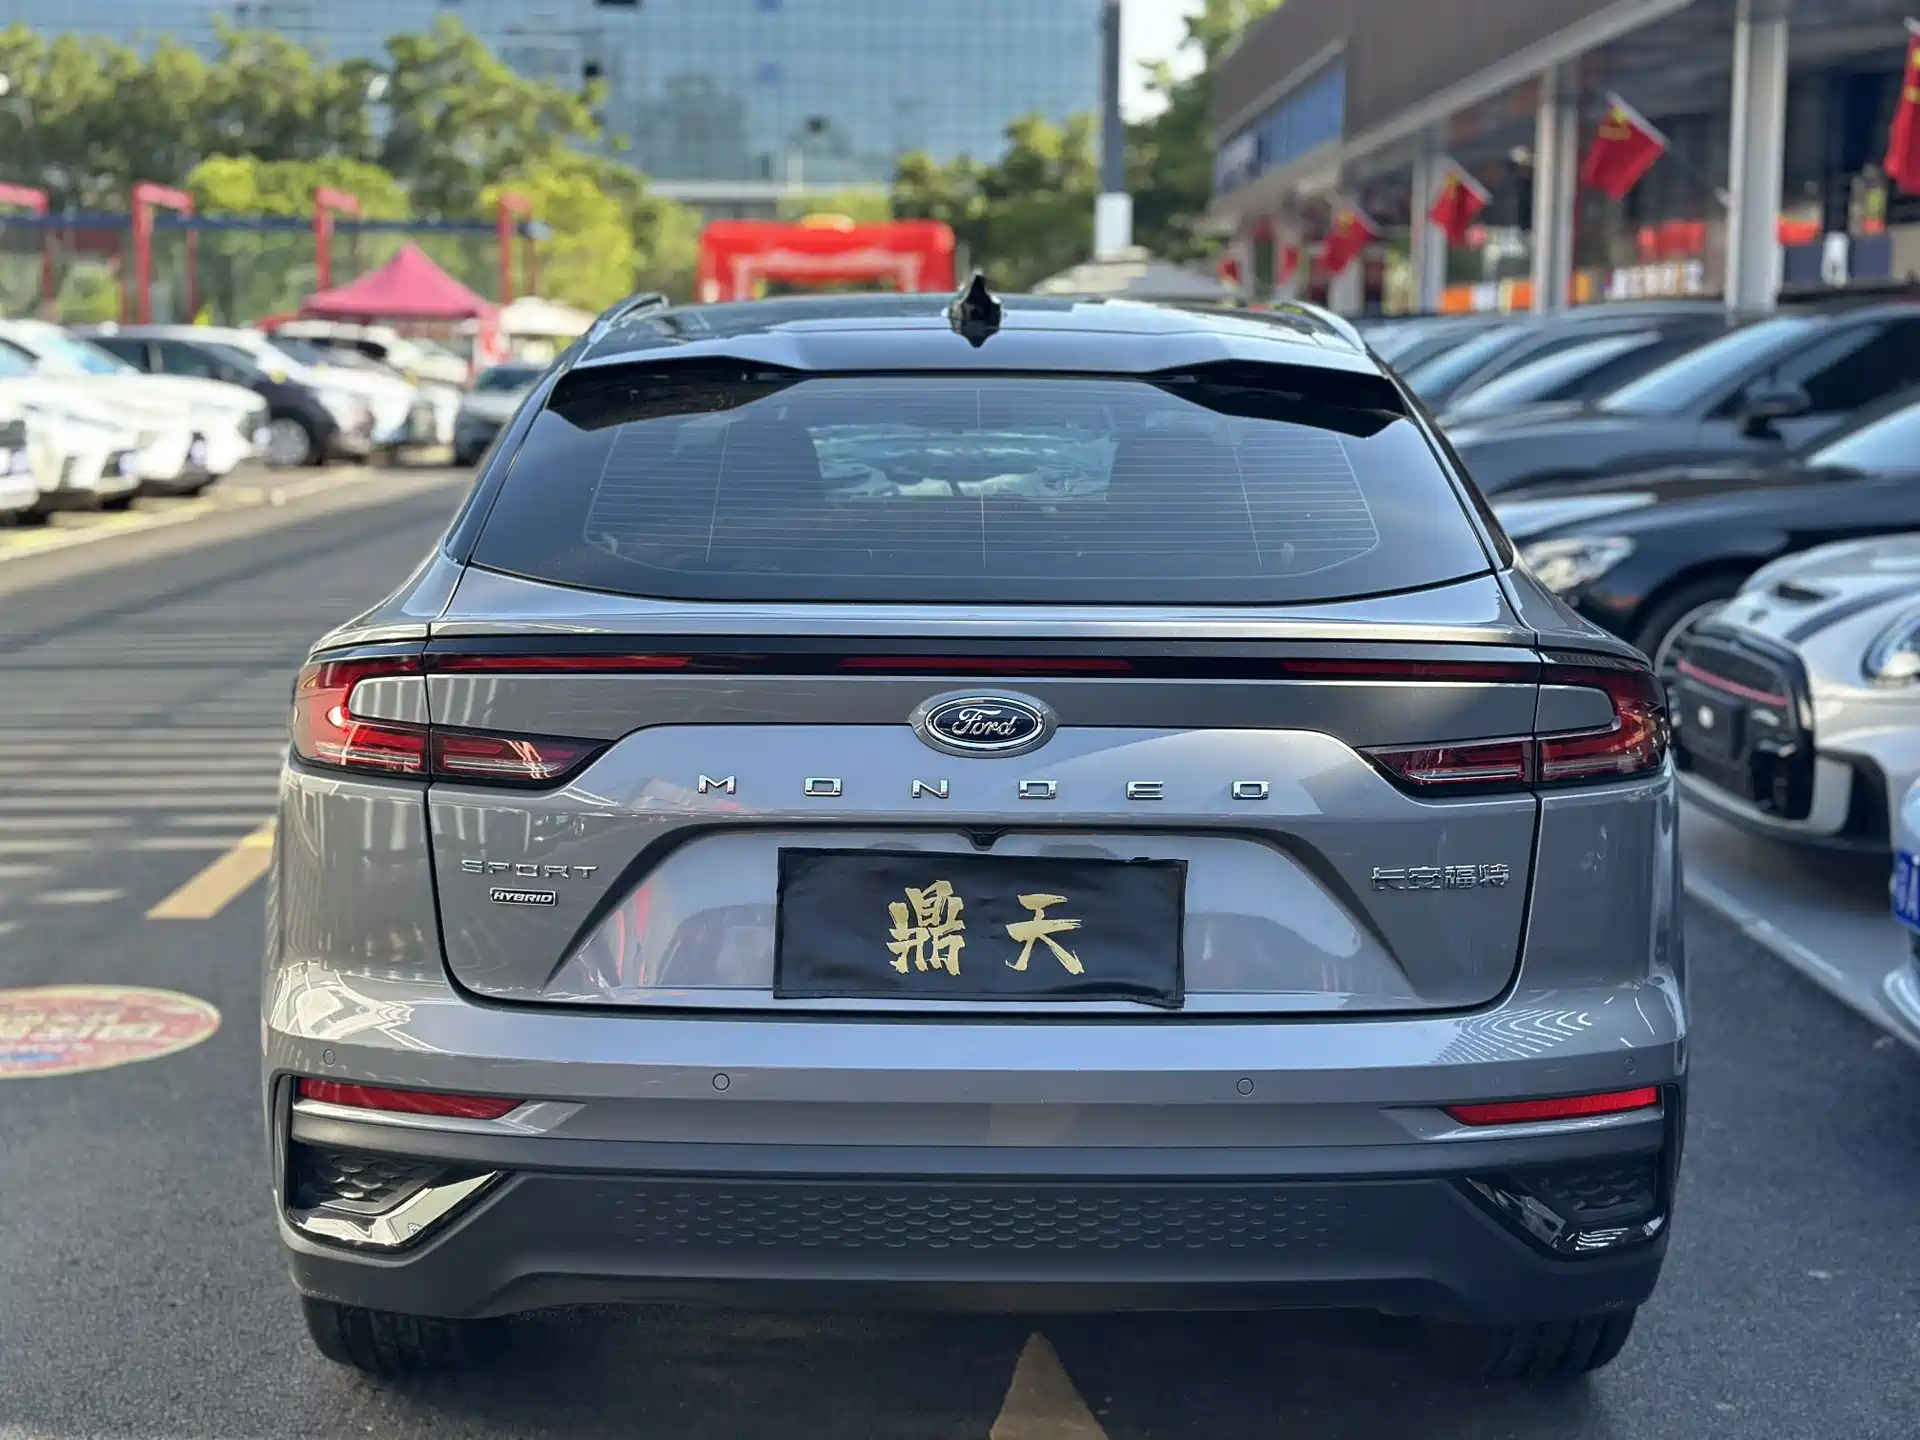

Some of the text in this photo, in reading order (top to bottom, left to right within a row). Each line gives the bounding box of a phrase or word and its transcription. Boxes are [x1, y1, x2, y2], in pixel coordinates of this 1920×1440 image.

[951, 708, 1018, 736] Ford
[697, 773, 1270, 801] MONDEO
[461, 859, 600, 879] SPORT
[1370, 863, 1510, 890] 长安福特
[493, 891, 553, 903] HYBRID
[885, 879, 1084, 977] 鼎天
